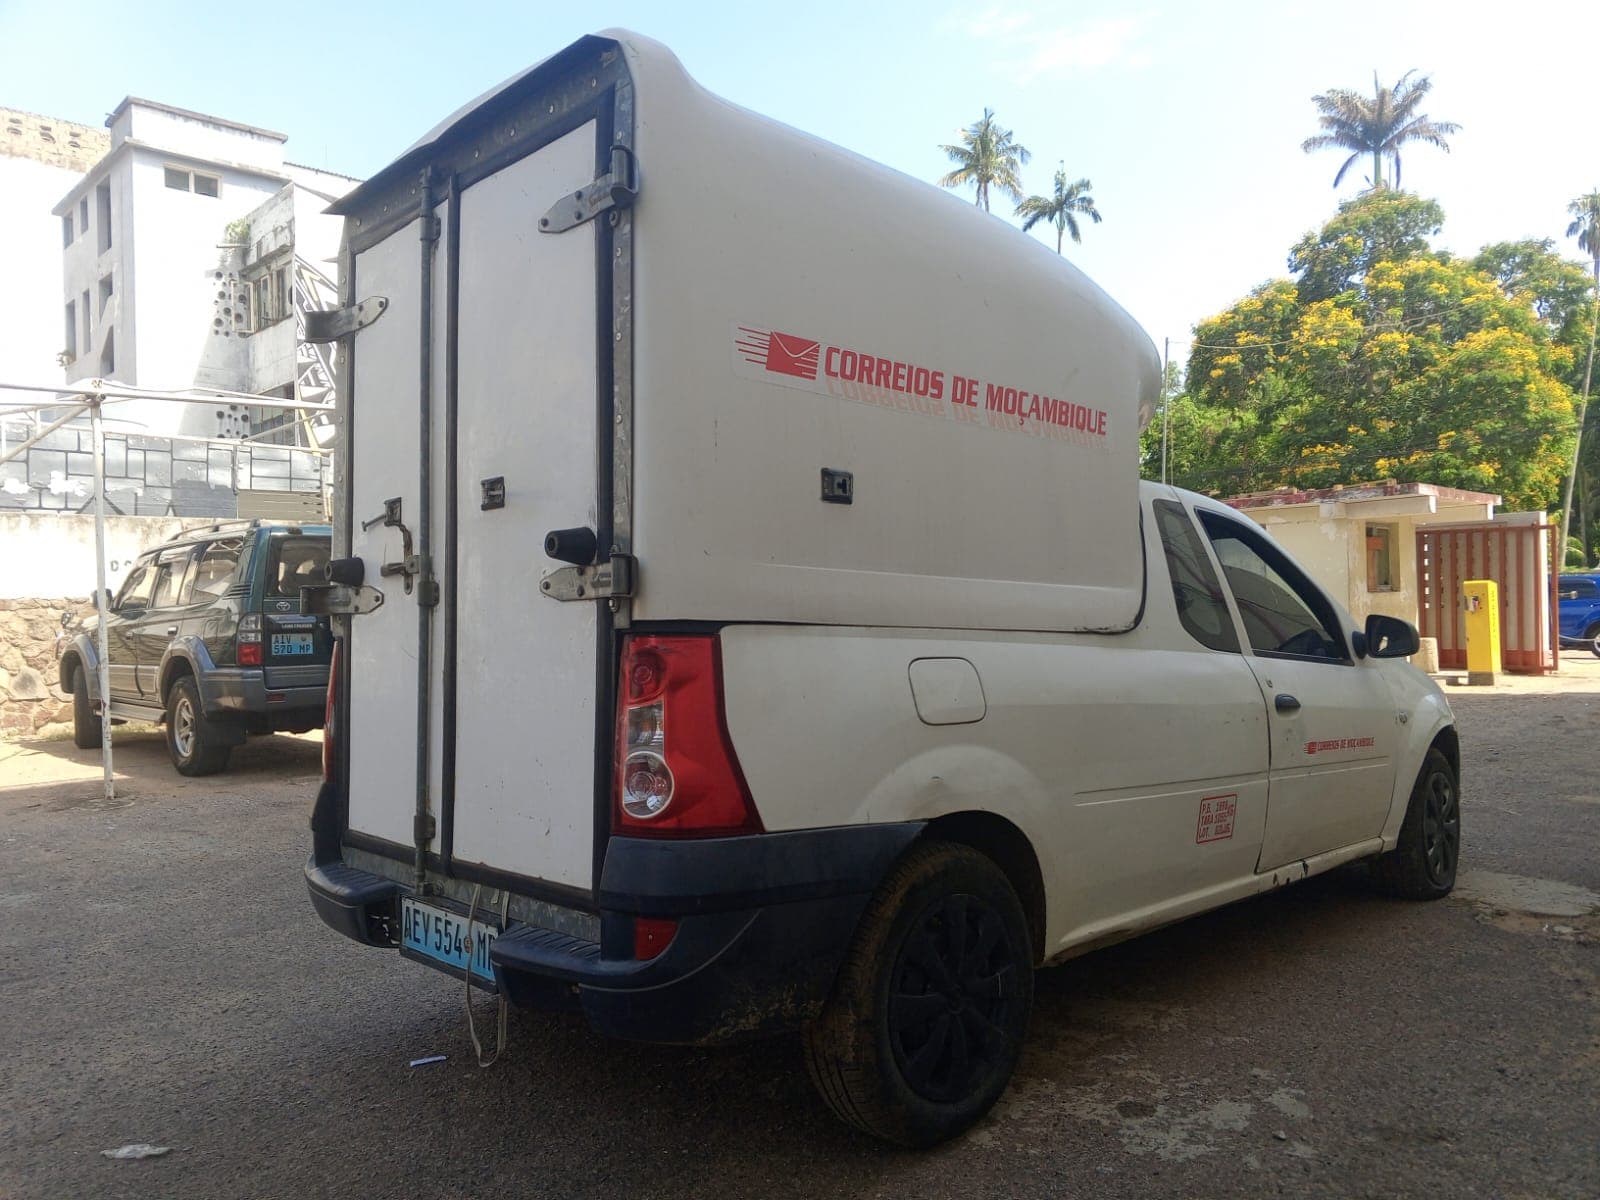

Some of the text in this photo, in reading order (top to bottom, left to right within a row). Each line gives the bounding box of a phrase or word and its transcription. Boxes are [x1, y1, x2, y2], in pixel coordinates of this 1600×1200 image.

[824, 346, 1107, 435] CORREIOS DE MOÇAMBIQUE
[404, 906, 430, 947] AEY
[434, 916, 463, 960] 554
